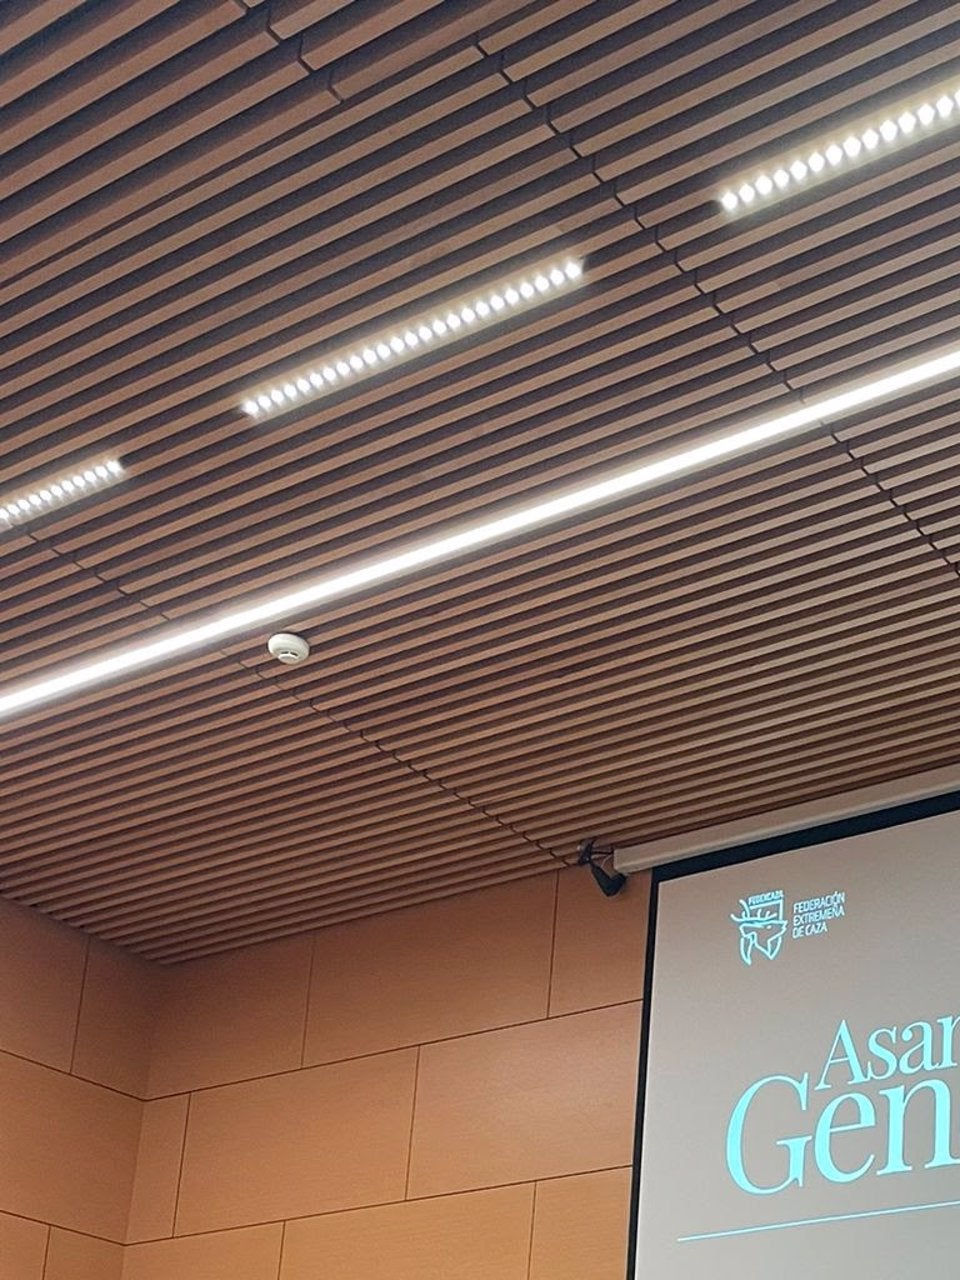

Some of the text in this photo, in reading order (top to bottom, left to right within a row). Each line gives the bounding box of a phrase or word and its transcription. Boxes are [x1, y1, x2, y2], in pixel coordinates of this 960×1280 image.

[793, 891, 846, 914] FEDERACIÓN
[793, 904, 846, 926] EXTREMEÑA
[792, 922, 828, 938] DE CAZA
